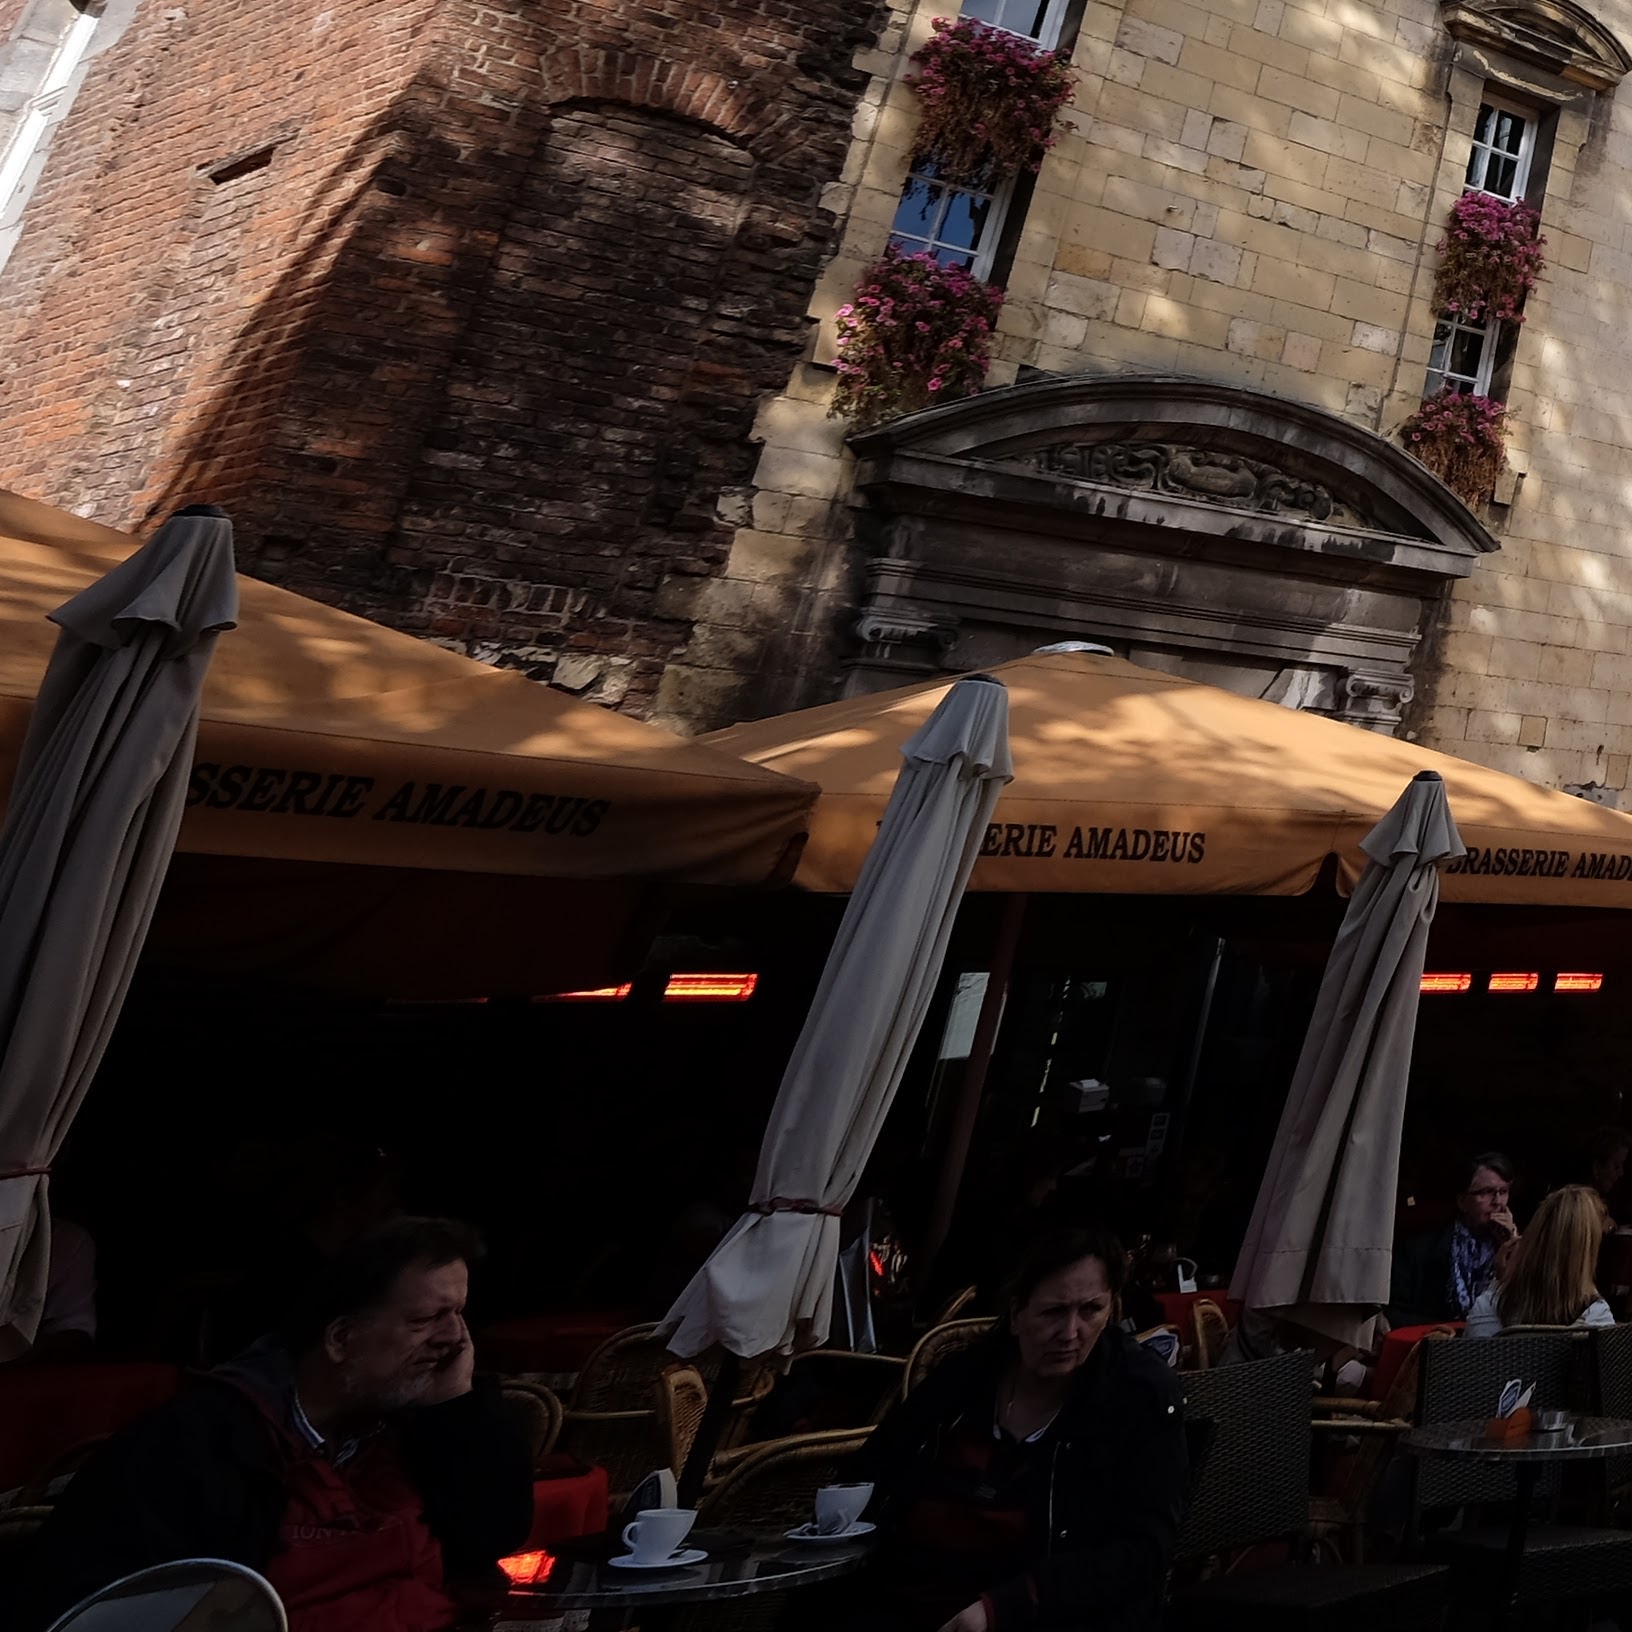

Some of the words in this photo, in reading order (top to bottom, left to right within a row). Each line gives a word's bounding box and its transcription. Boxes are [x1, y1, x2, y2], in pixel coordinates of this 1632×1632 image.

[186, 762, 374, 818] SSERIE
[373, 781, 610, 836] AMADEUS
[1063, 826, 1206, 864] AMADEUS
